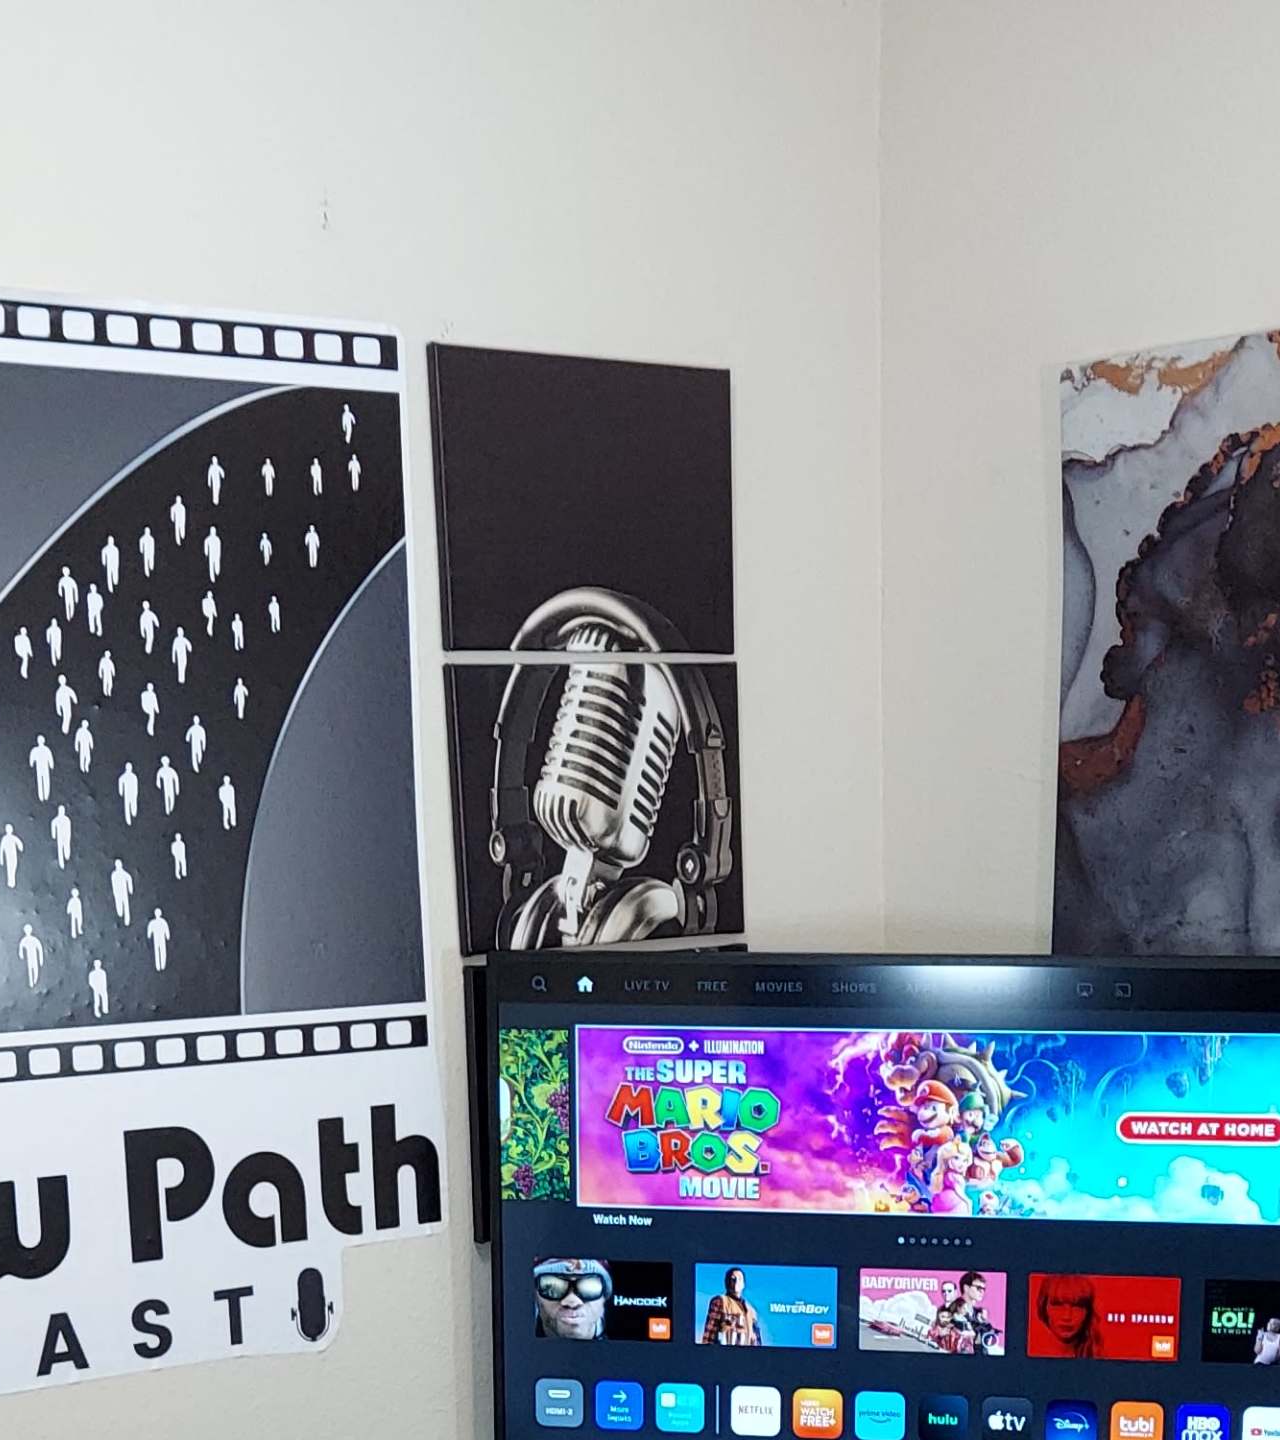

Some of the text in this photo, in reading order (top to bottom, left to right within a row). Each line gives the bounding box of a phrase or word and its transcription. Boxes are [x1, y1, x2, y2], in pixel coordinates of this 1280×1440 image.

[624, 980, 670, 992] LIVE TV
[696, 981, 728, 993] FREE
[755, 982, 803, 993] MOVIES
[832, 982, 877, 994] SHOWS
[628, 1040, 679, 1051] Nintendo
[704, 1039, 765, 1055] ILLUMINATION
[625, 1059, 747, 1084] THE SUPER
[605, 1082, 782, 1133] MARIO
[1131, 1120, 1276, 1137] WATCH AT HOME
[622, 1128, 771, 1175] BROS.
[122, 1103, 442, 1264] Path
[679, 1177, 761, 1199] MOVIE
[593, 1213, 653, 1227] Watch Now
[861, 1275, 939, 1291] BABY DRIVER
[614, 1295, 668, 1308] HANCOCK
[1211, 1311, 1256, 1329] LOL!
[738, 1404, 773, 1416] NETFLIX
[800, 1407, 835, 1417] WATCH
[928, 1412, 958, 1426] hulu
[1004, 1413, 1026, 1431] tv
[1187, 1415, 1221, 1430] HBO
